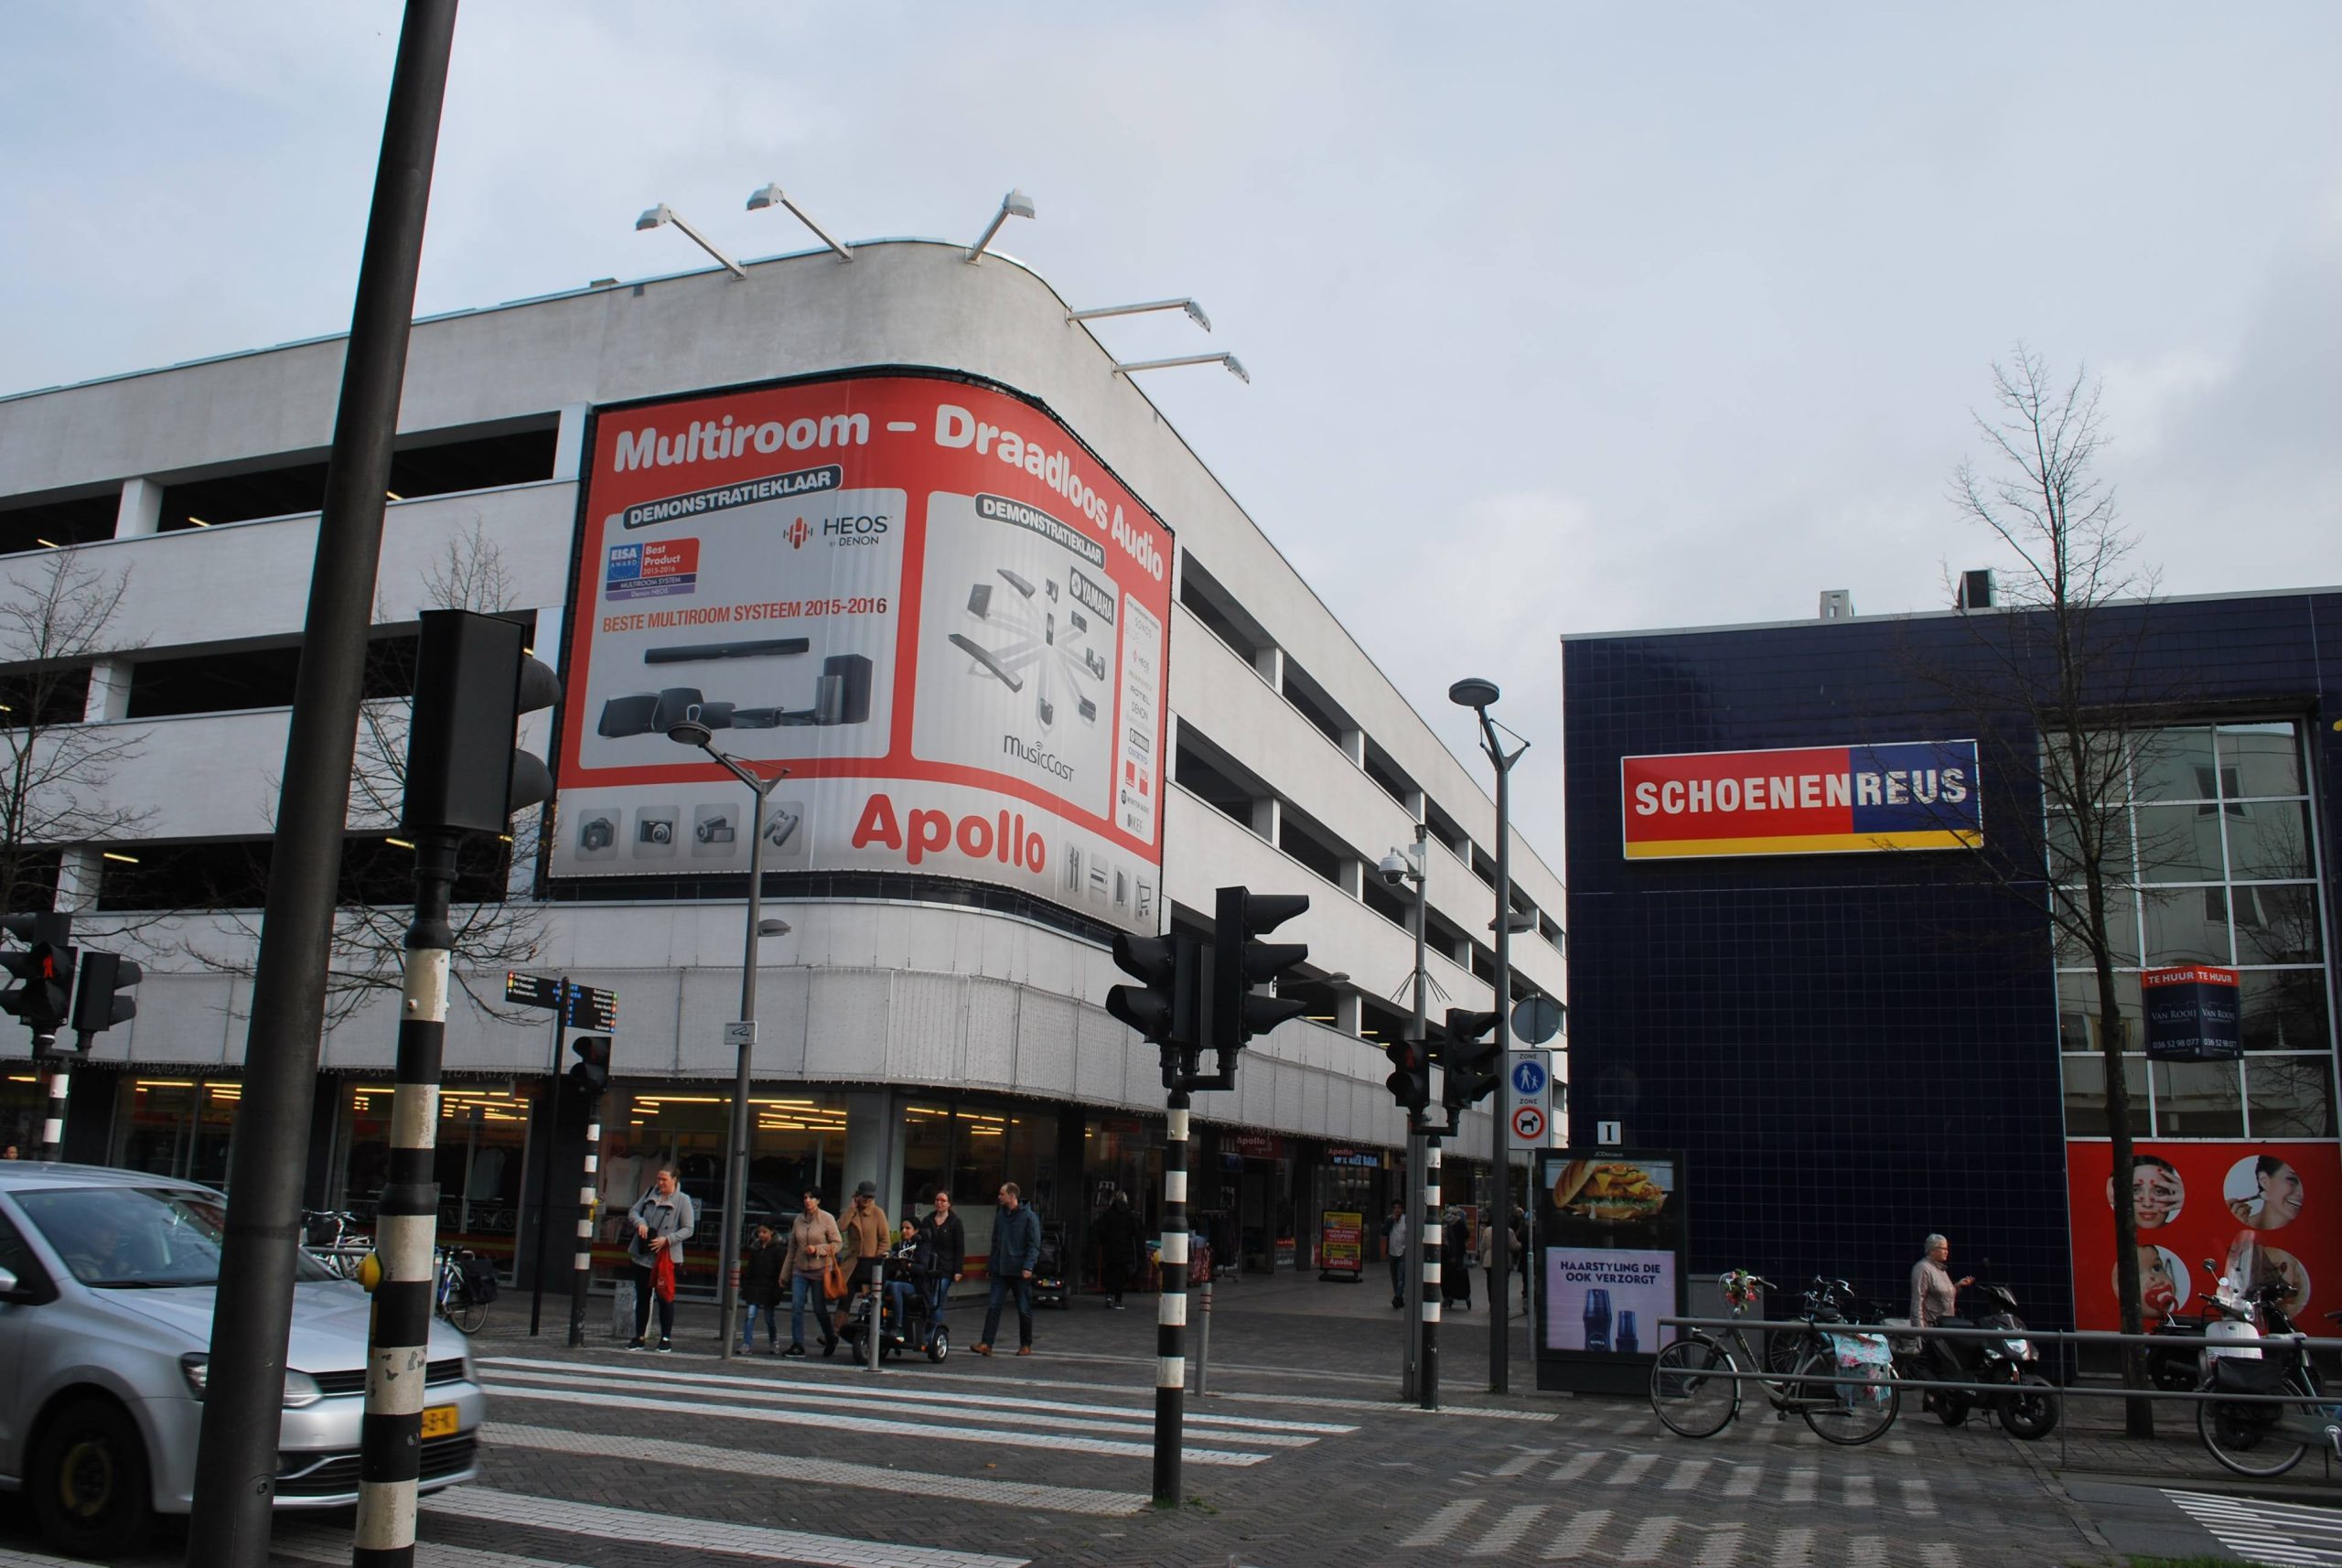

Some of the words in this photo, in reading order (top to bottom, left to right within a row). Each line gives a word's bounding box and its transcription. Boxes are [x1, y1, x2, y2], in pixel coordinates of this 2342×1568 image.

[614, 413, 870, 472] Multiroom
[935, 403, 1108, 531] Draadloos
[1111, 504, 1163, 581] Audio
[628, 470, 833, 526] DEMONSTRATIEKLAAR
[823, 516, 888, 536] HEOS
[982, 499, 1102, 565] DEMONSTRATIEKLAAR
[839, 535, 879, 547] DENON
[610, 547, 638, 561] EISA
[645, 545, 666, 555] Best
[644, 554, 682, 566] Product
[643, 566, 676, 575] 2015-2016
[620, 578, 658, 589] MULTIROOM
[658, 576, 682, 585] SYSTEM
[1082, 581, 1112, 622] YAMAHA
[602, 615, 646, 634] BESTE
[647, 607, 730, 629] MULTIROOM
[733, 602, 801, 623] SYSTEEM
[805, 597, 887, 618] 2015-2016
[1131, 701, 1149, 721] DENON
[852, 793, 1046, 875] Apollo
[2163, 972, 2195, 983] HUUR
[2197, 972, 2208, 980] TE
[2209, 972, 2232, 983] HUUR
[2152, 1012, 2168, 1020] VAN
[2201, 1009, 2216, 1018] VAN
[2186, 1038, 2199, 1047] 077
[1236, 1136, 1266, 1146] Apollo
[1327, 1147, 1354, 1156] Apollo
[1329, 1258, 1353, 1266] Apollo
[1560, 1261, 1639, 1273] HAARSTYLING
[1643, 1263, 1661, 1273] DIE
[1565, 1273, 1592, 1283] OOK
[1595, 1273, 1656, 1285] VERZORGT
